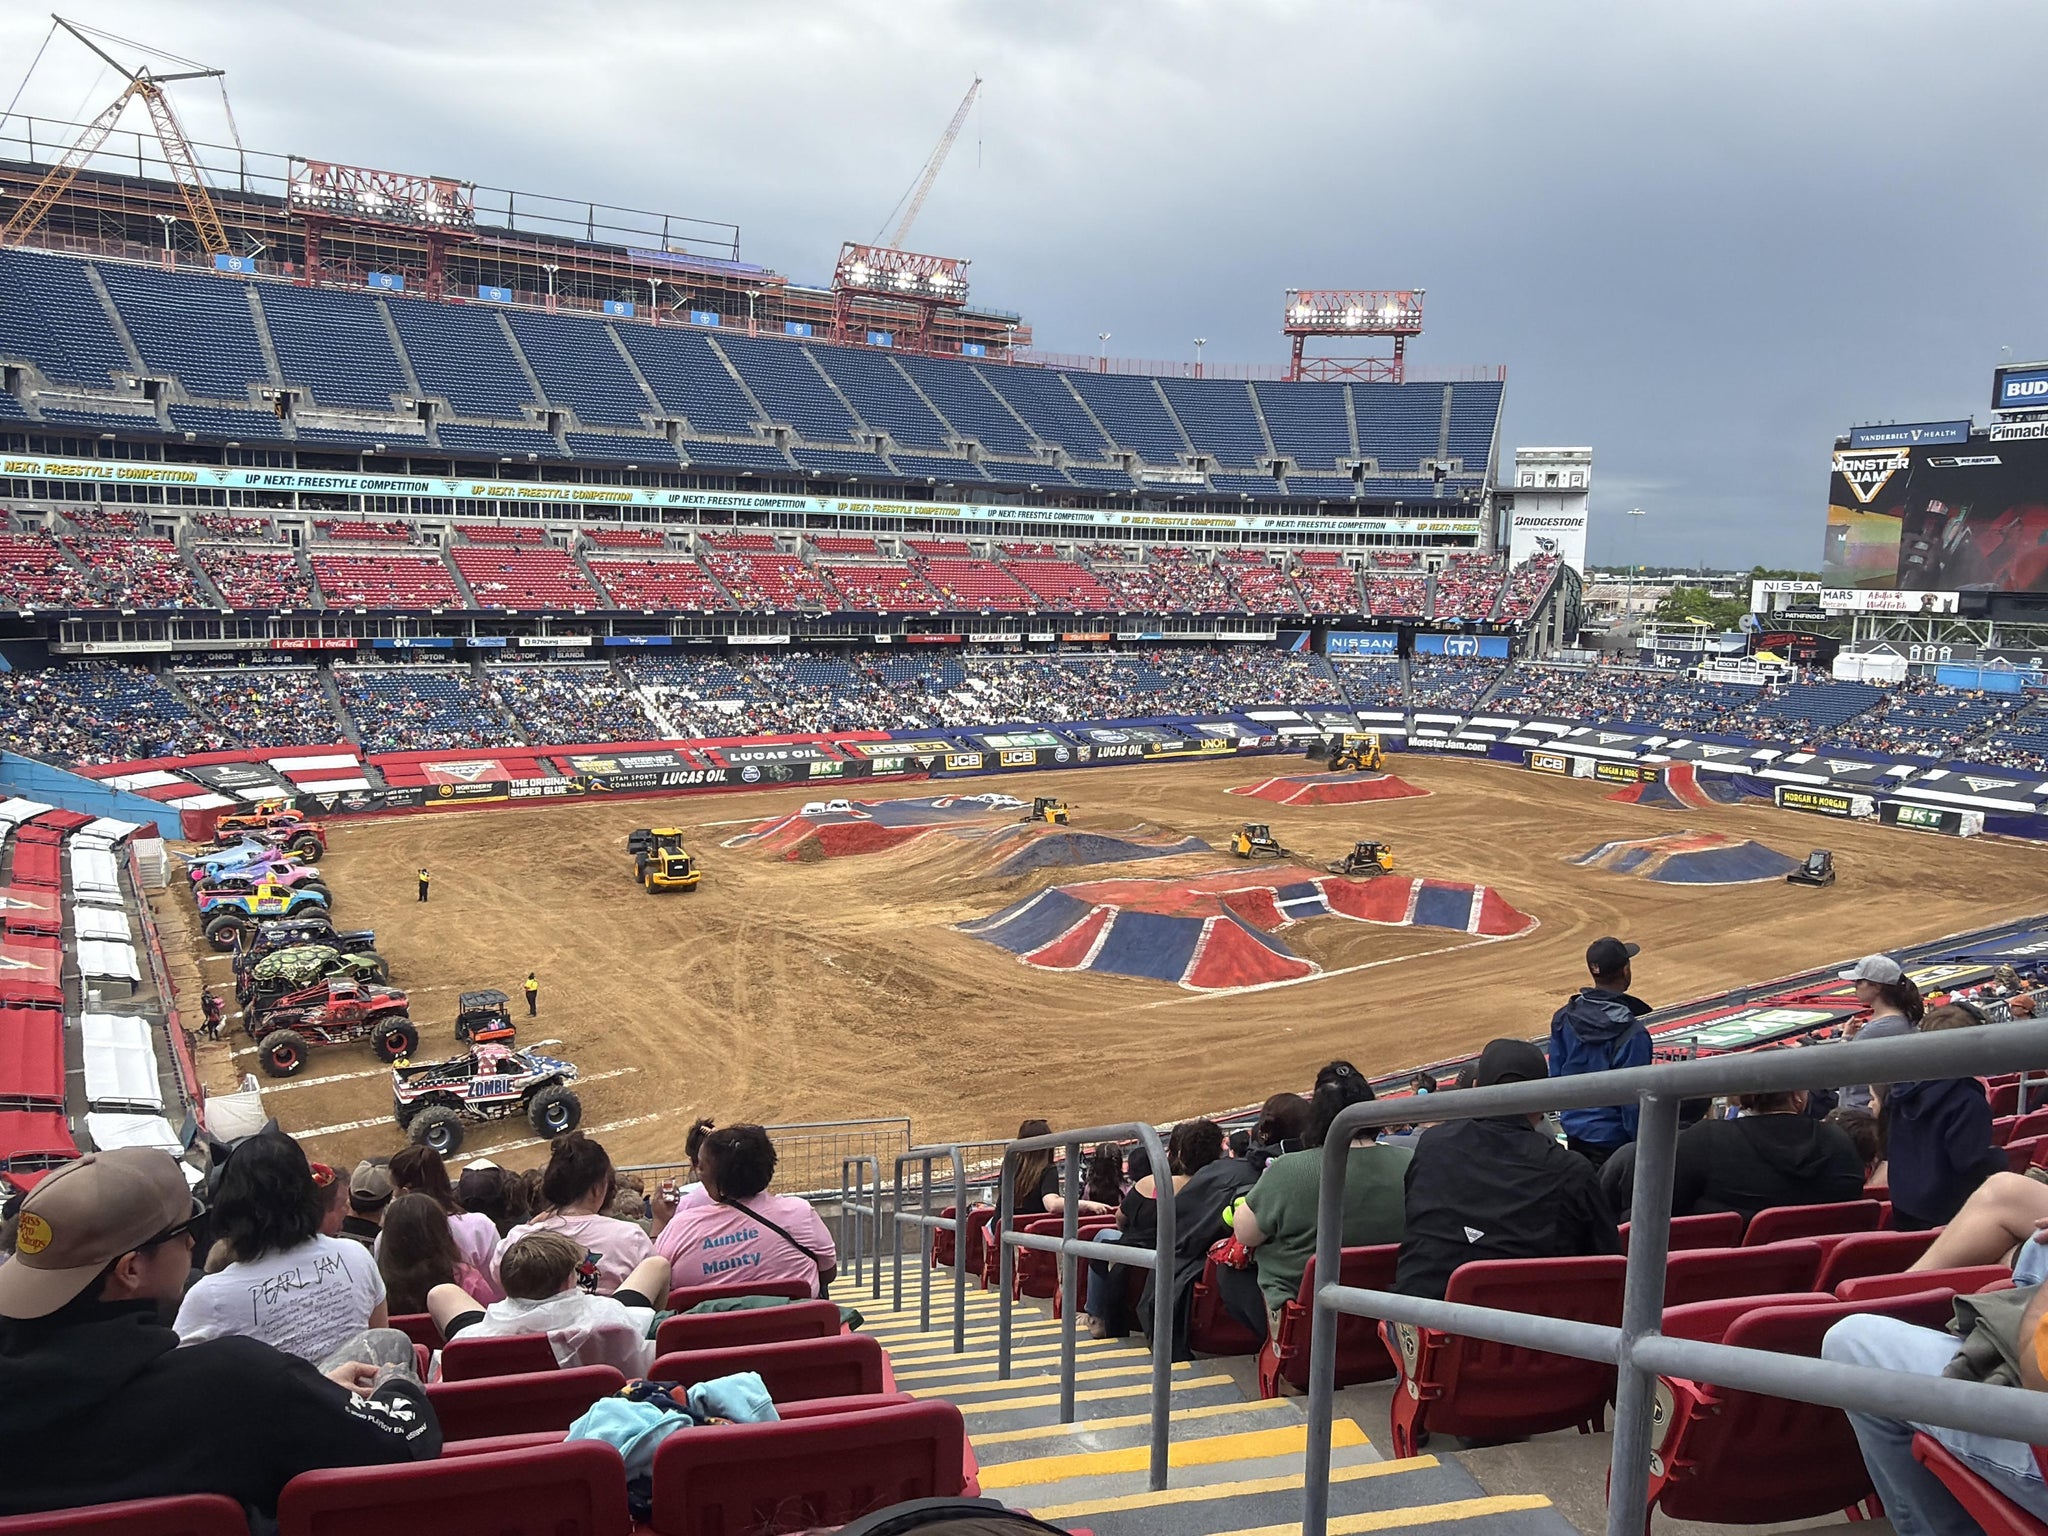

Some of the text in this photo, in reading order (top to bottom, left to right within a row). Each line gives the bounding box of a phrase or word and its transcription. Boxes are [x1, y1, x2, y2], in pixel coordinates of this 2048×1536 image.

[2007, 381, 2048, 397] BUD
[1860, 433, 1908, 442] VANDERBILT
[1924, 430, 1957, 438] HEALTH
[1832, 457, 1909, 472] MONSTER
[4, 460, 197, 484] NEXT: FREESTYLE COMPETITION
[1849, 469, 1887, 483] JAM
[245, 474, 429, 493] UP NEXT: FREESTYLE COMPETITION
[471, 485, 633, 502] UP NEXT: FREESTYLE COMPETITION
[668, 494, 806, 509] UP NEXT: FREESTYLE COMPETITION
[837, 502, 960, 516] UP NEXT: FREESTYLE COMPETITION
[987, 508, 1094, 521] UP NEXT: FREESTYLE COMPETITION
[1276, 520, 1295, 528] NEXT:
[1297, 521, 1336, 529] FREESTYLE
[1338, 521, 1386, 529] COMPETITION
[1514, 516, 1585, 528] BRIDGESTONE
[1823, 591, 1853, 600] MARS
[1785, 612, 1826, 621] PATHFINDER
[1332, 638, 1393, 649] NISSAN
[1718, 660, 1737, 668] ROCKY
[1200, 737, 1227, 749] UNOH
[1408, 736, 1487, 753] MonsterJam.com
[730, 751, 788, 762] LUCAS
[1004, 751, 1033, 763] JCB
[1097, 745, 1127, 758] LUCAS
[872, 758, 904, 771] BKT
[949, 754, 980, 767] JCB
[1534, 757, 1563, 769] JCB
[809, 761, 843, 775] BKT
[1598, 765, 1619, 775] MORGAN
[510, 776, 571, 788] THE ORIGINAL
[610, 780, 657, 789] COMMISSION
[661, 771, 704, 786] LUCAS
[510, 786, 567, 798] SUPER GLUE
[1784, 792, 1811, 804] MORGAN
[1818, 797, 1848, 809] MORGAN
[1899, 809, 1942, 825] BKT
[467, 1080, 513, 1098] ZOMBIE
[702, 1228, 759, 1250] Auntie
[248, 1268, 311, 1326] PEARL
[312, 1253, 353, 1287] JAM
